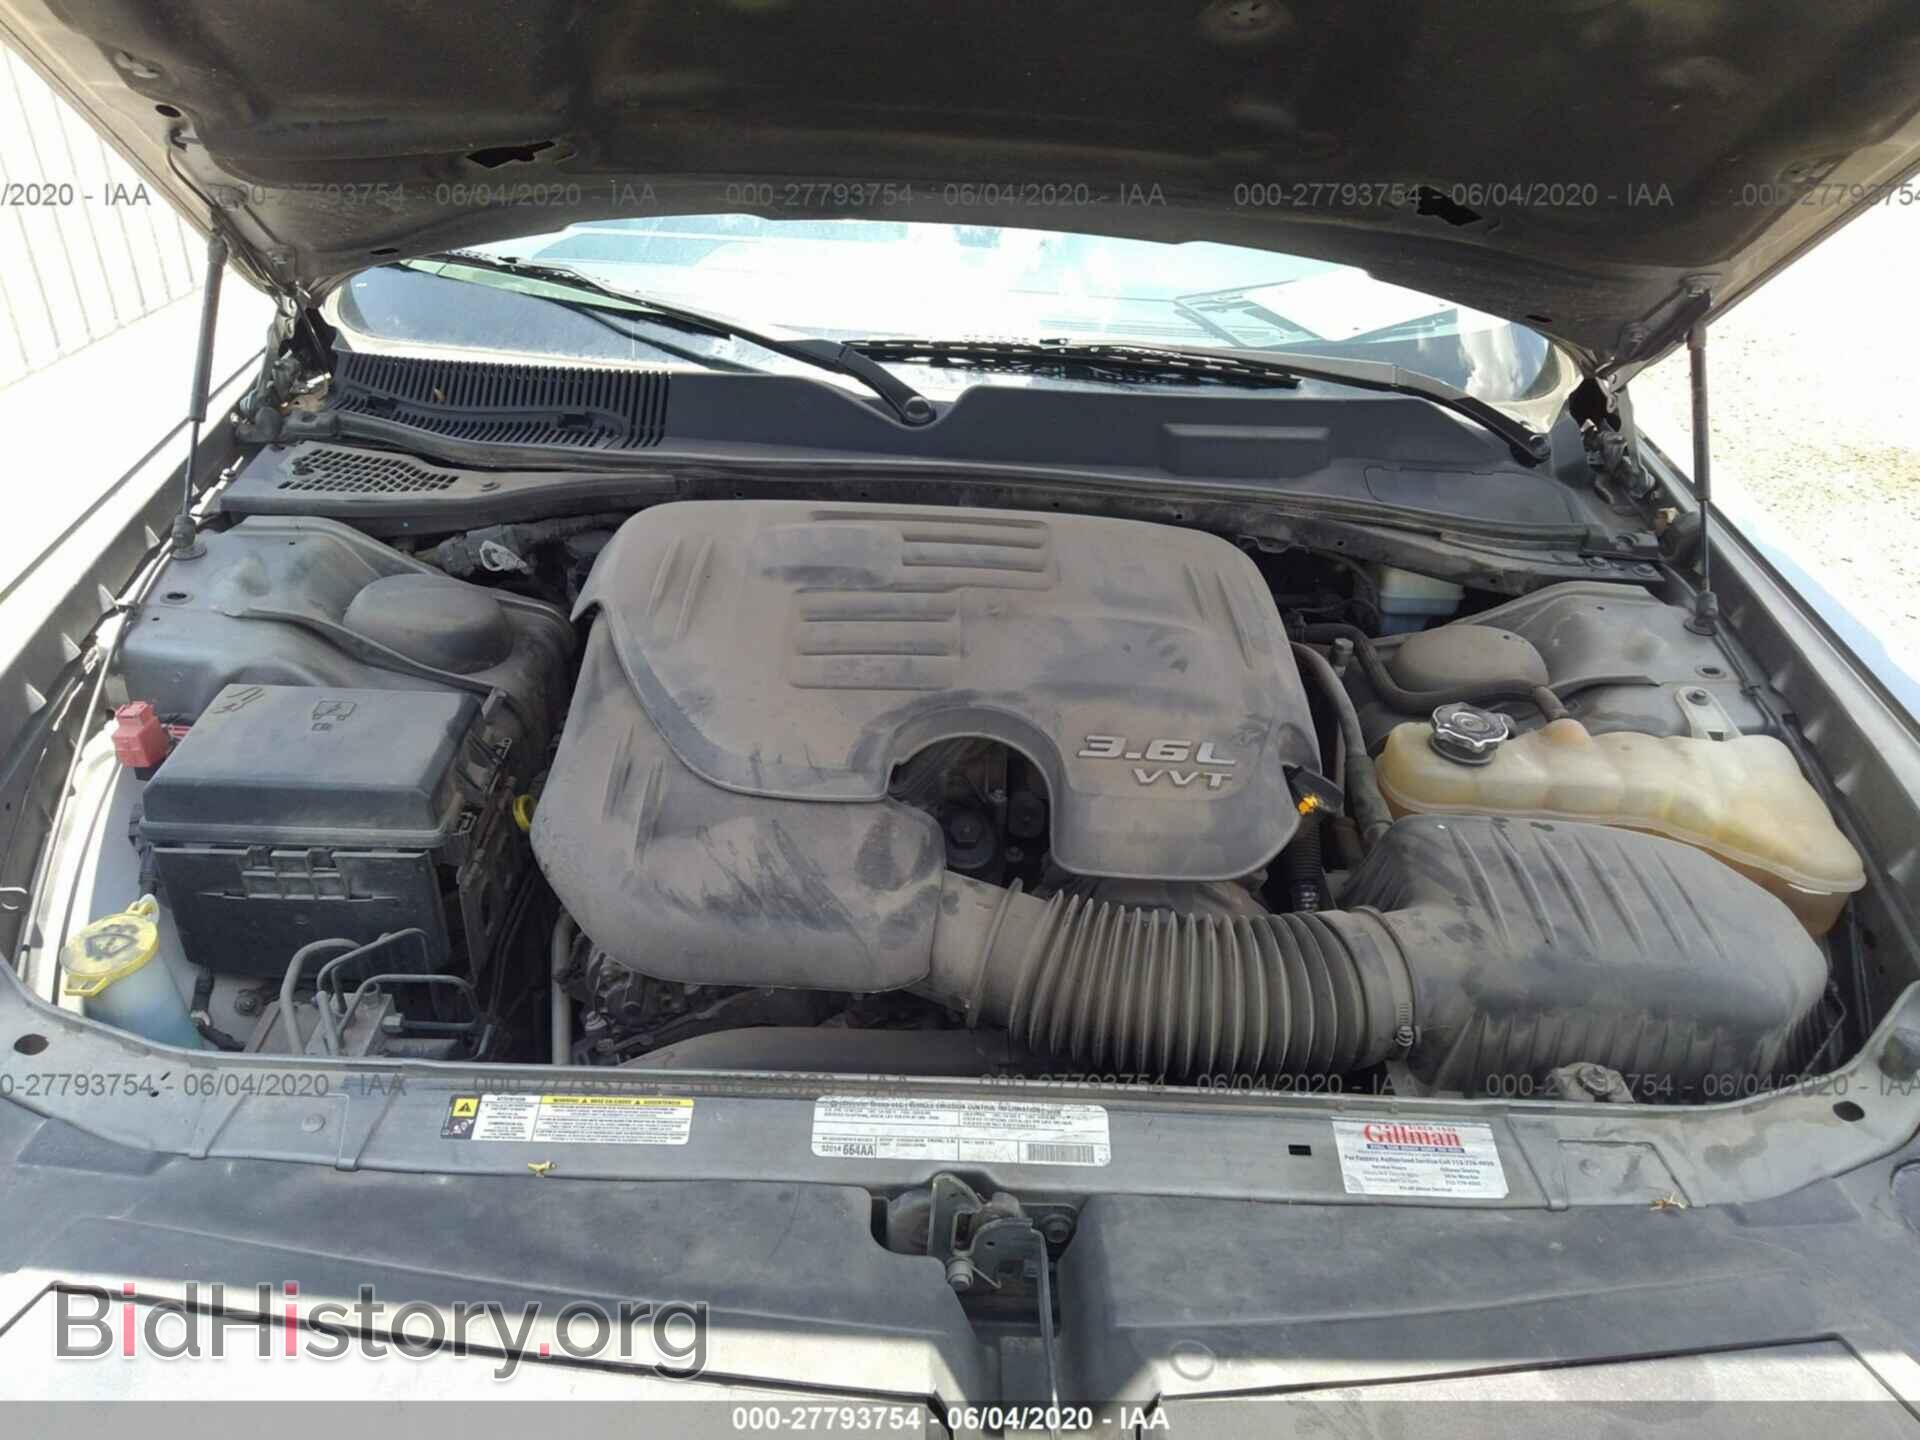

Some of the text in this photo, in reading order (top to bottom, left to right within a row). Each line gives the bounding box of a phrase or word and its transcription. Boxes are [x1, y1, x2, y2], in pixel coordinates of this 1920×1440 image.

[1077, 735, 1237, 766] 3.6L
[1132, 767, 1233, 788] VVT
[1363, 1121, 1461, 1147] Gillman
